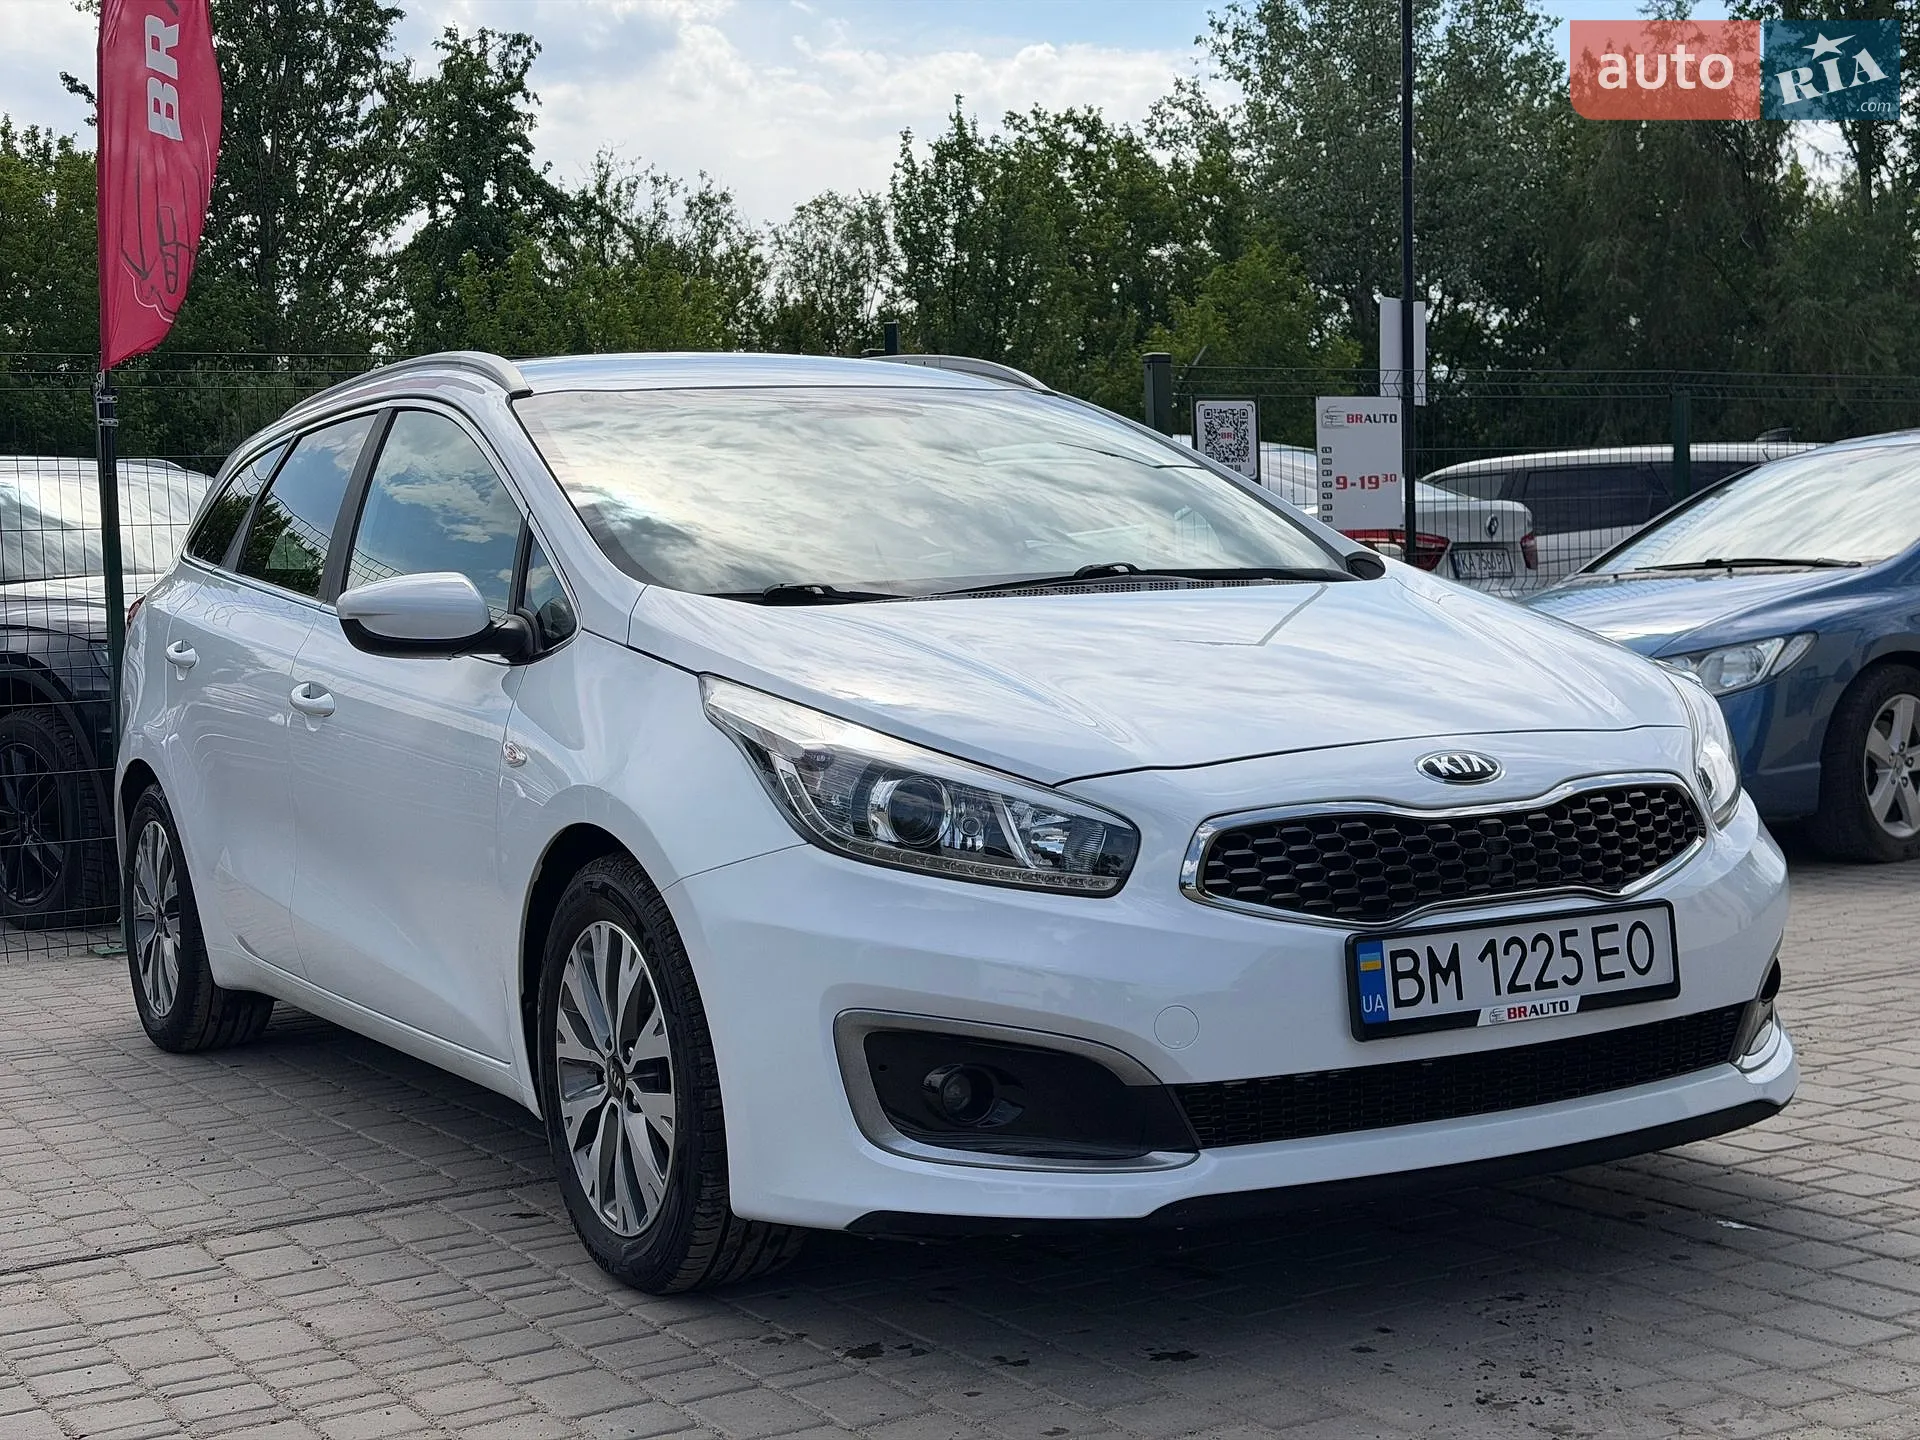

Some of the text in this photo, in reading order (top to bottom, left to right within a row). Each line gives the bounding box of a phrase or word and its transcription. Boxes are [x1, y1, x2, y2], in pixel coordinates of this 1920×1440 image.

[145, 0, 183, 141] BR
[1346, 413, 1398, 424] BRAUTO
[1423, 754, 1494, 777] KIA
[1389, 920, 1655, 1009] BM 1225 EO
[1362, 994, 1385, 1013] UA
[1507, 1000, 1569, 1020] BRAUTO
